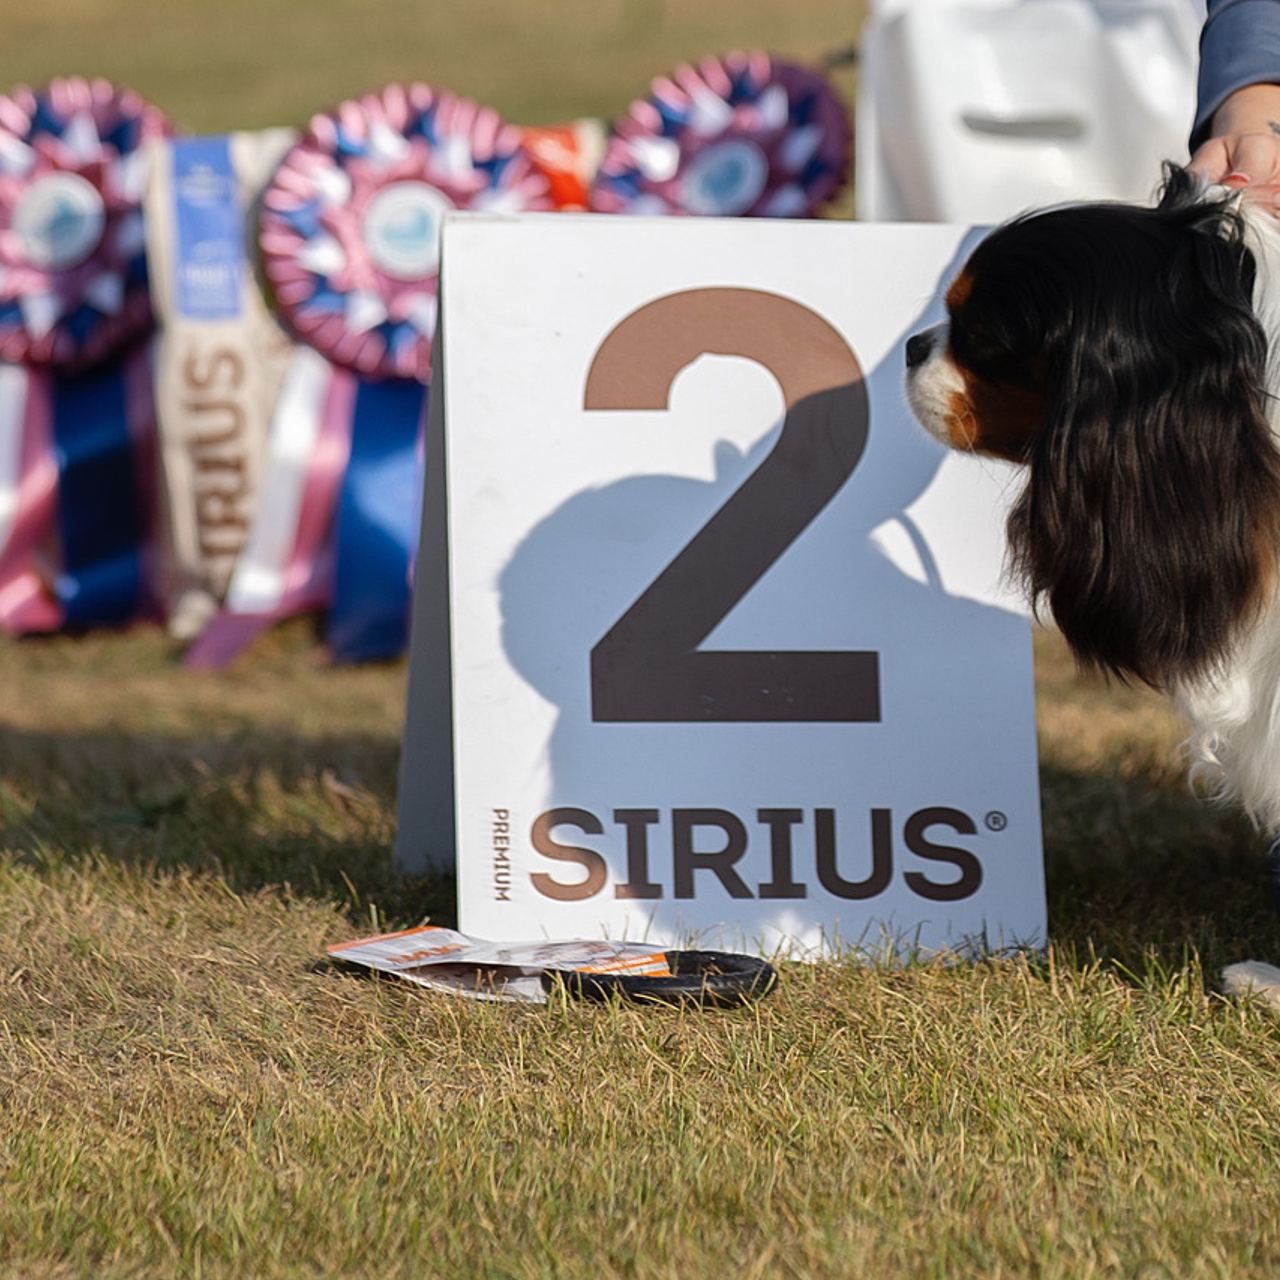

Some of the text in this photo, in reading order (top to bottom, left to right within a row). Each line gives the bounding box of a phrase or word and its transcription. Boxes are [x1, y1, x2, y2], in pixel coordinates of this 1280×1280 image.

[182, 347, 248, 560] IRIUS
[583, 286, 882, 724] 2
[492, 808, 512, 902] PREMIUM
